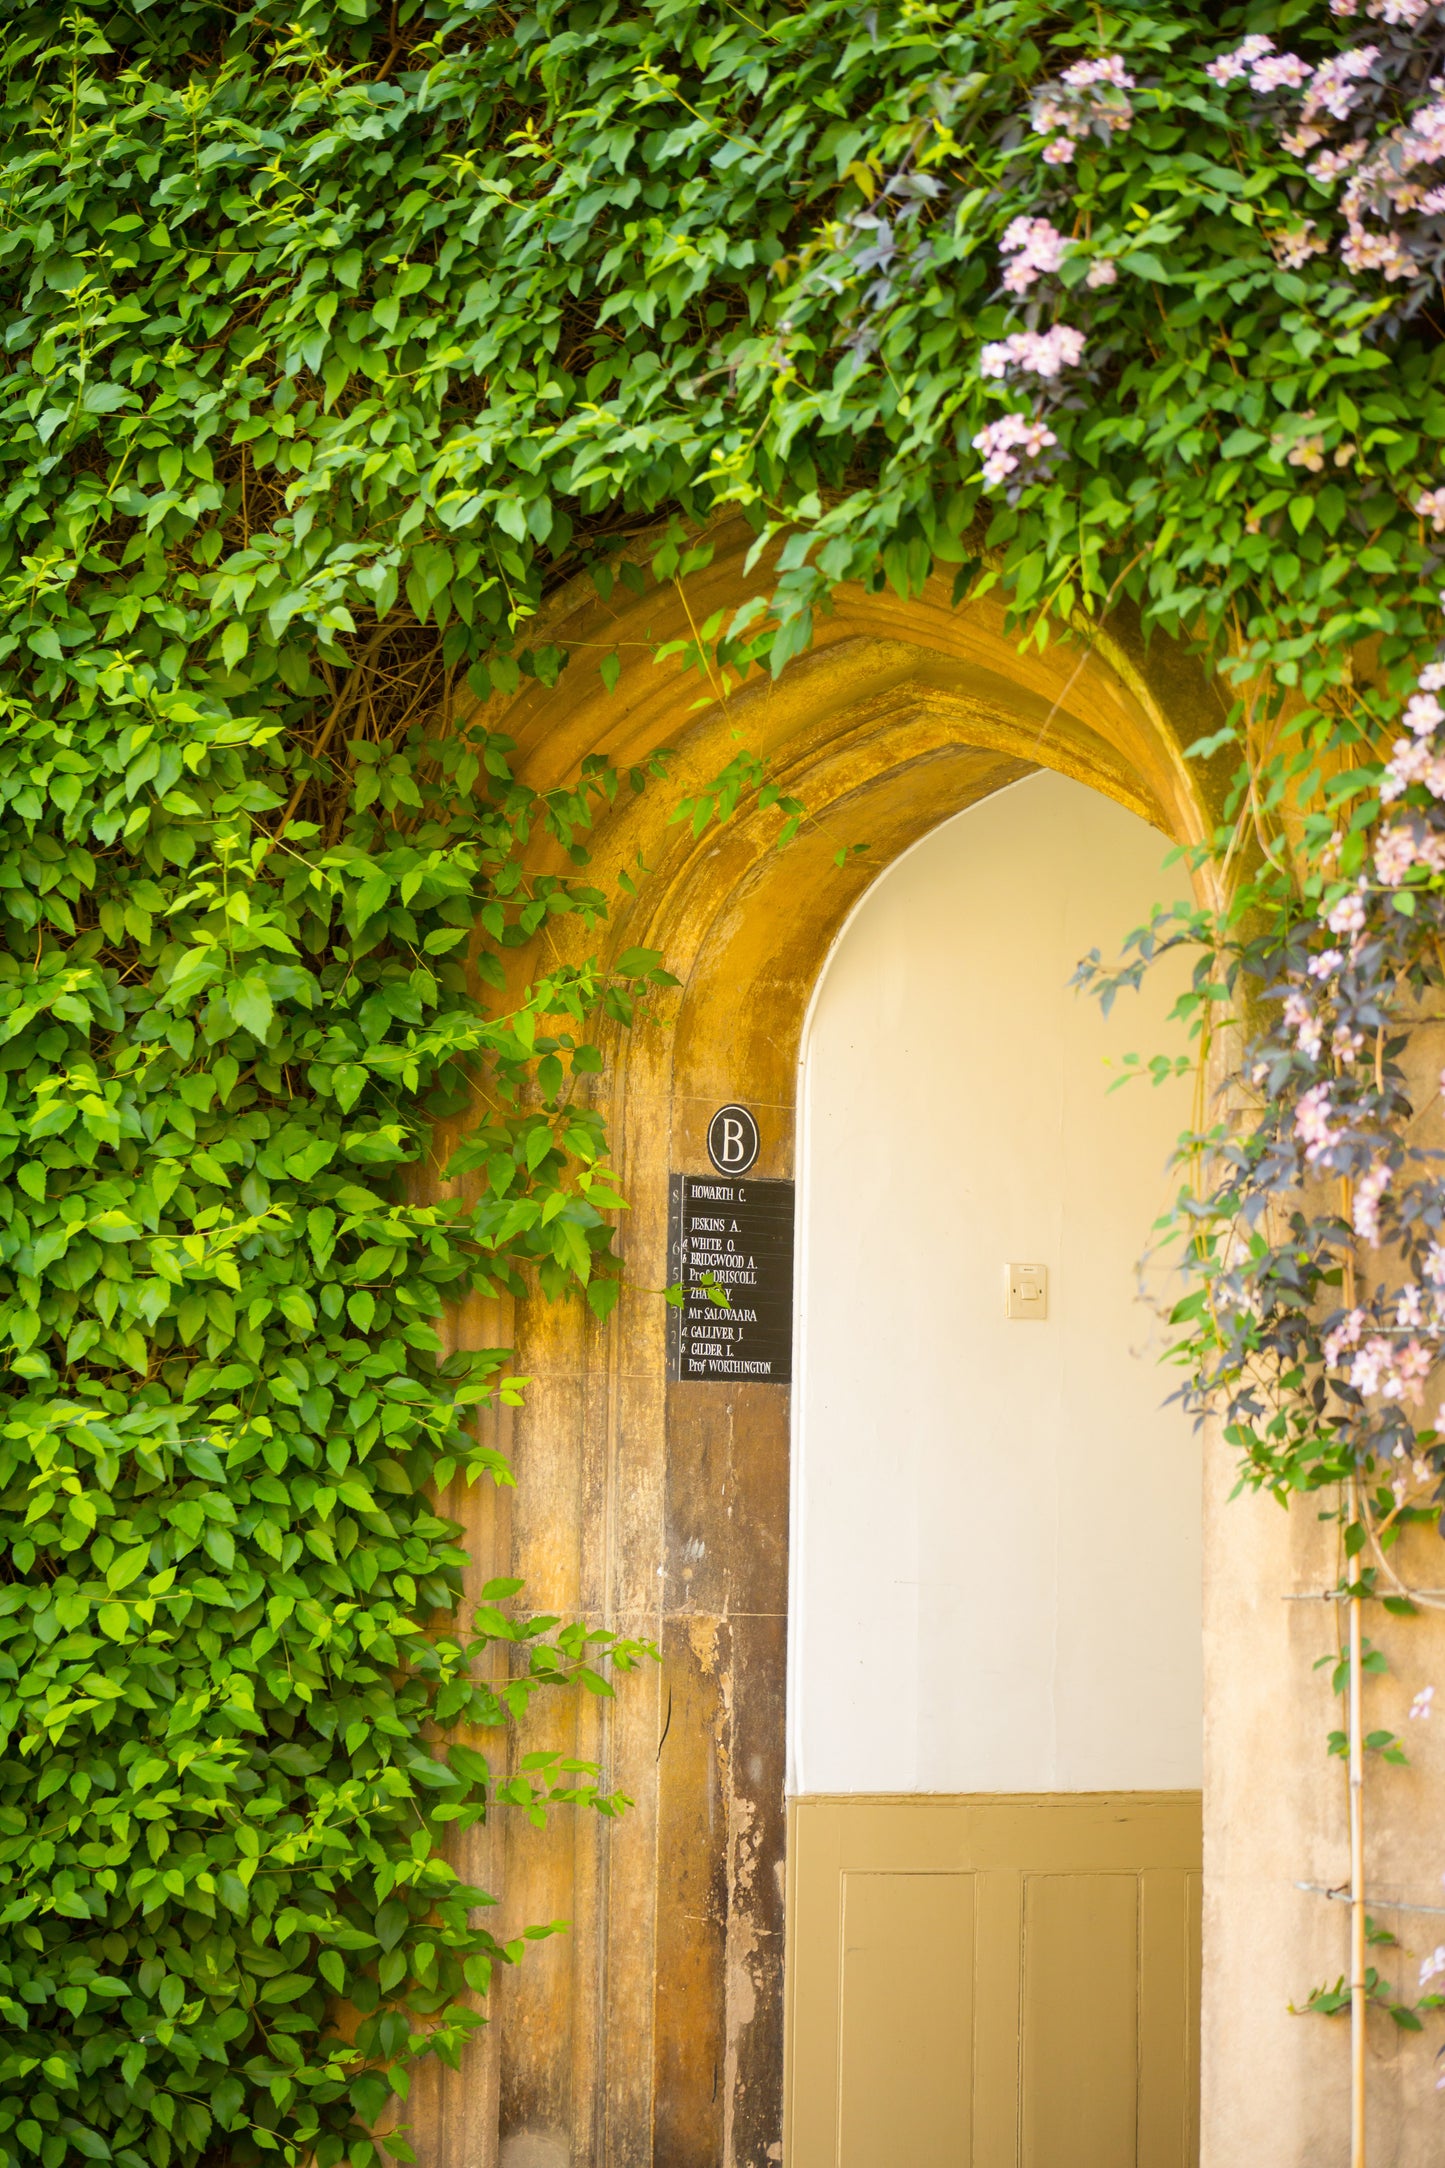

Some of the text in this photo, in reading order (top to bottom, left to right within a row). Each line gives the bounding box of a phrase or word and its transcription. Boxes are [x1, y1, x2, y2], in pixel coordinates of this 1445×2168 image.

[722, 1118, 744, 1162] B
[691, 1185, 734, 1201] HOWARTH
[738, 1188, 747, 1202] C.
[689, 1217, 725, 1232] JESKINS
[729, 1220, 742, 1233] A.
[691, 1237, 722, 1251] WHITE
[727, 1239, 736, 1252] O.
[689, 1252, 745, 1269] BRIDGWOOD
[747, 1256, 758, 1269] A.
[713, 1269, 757, 1285] DRISCOLL
[690, 1288, 722, 1301] ZHA
[688, 1307, 703, 1320] Mr
[704, 1307, 758, 1322] SALOVAARA
[690, 1326, 735, 1341] GALLIVER
[734, 1328, 744, 1343] J.
[691, 1343, 723, 1357] GILDER
[688, 1358, 706, 1375] Prof
[708, 1360, 772, 1375] WORTHINGTON
